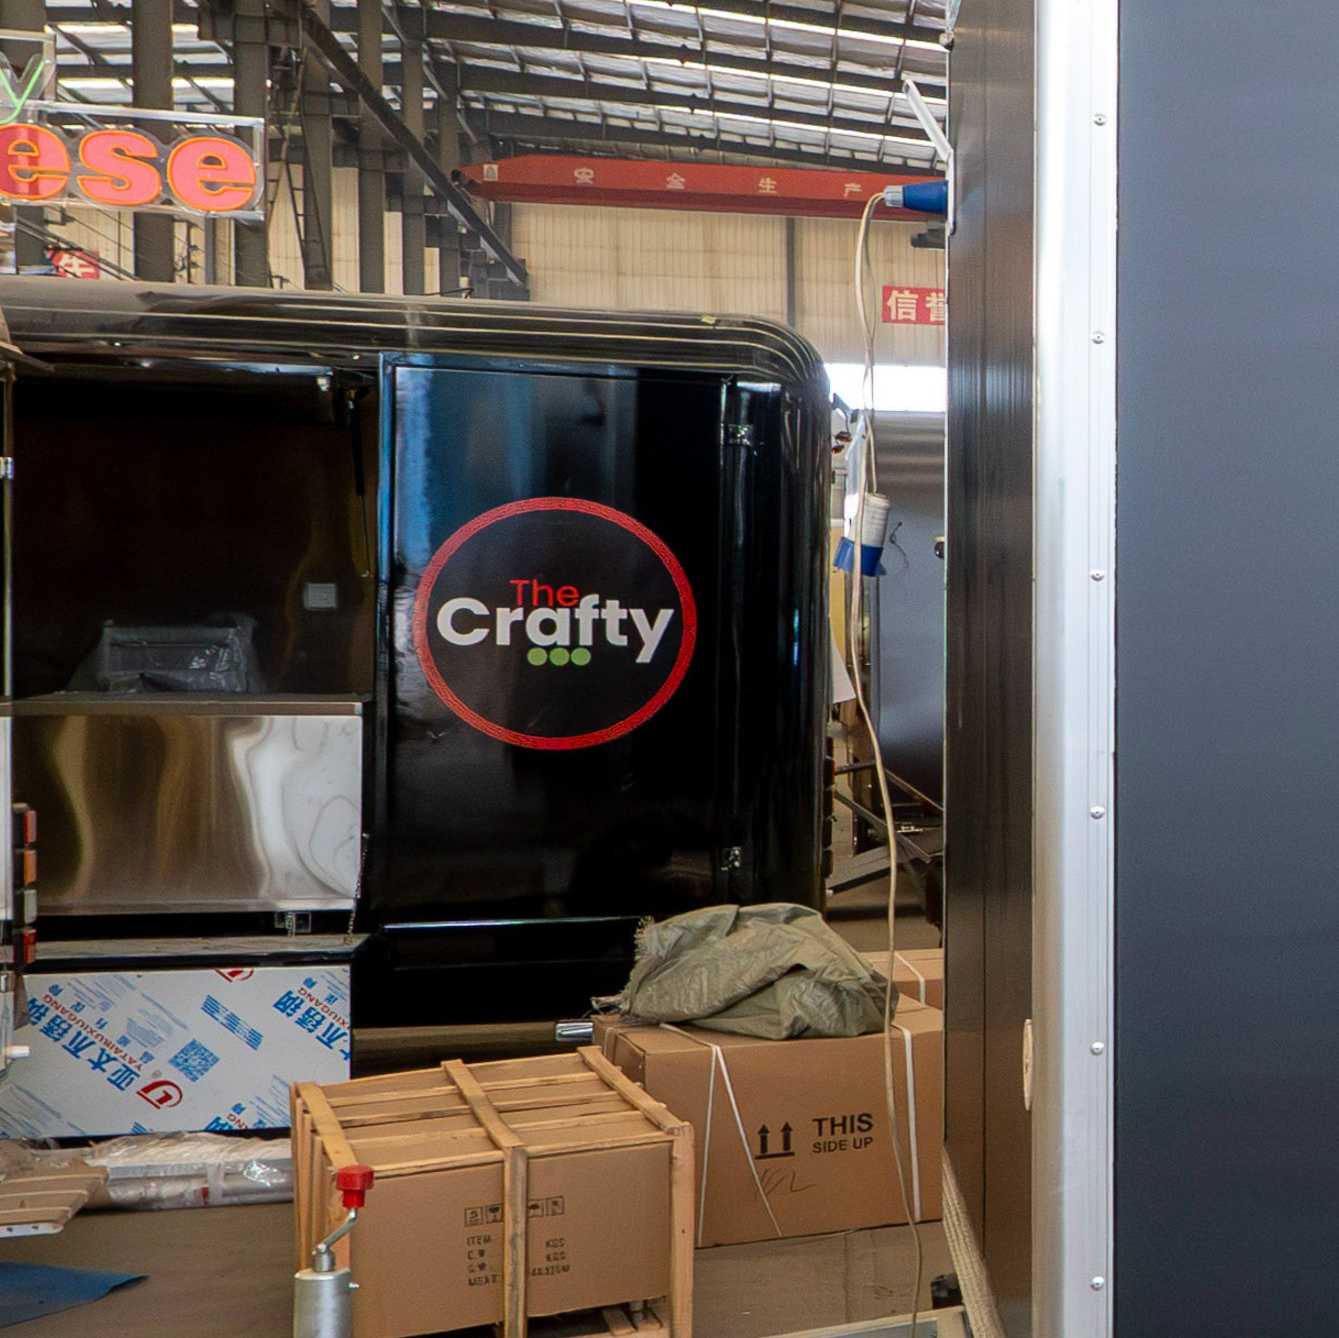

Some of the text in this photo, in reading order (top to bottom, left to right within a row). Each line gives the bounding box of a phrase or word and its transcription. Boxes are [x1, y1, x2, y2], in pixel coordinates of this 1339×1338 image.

[510, 578, 580, 607] The
[436, 594, 675, 663] Crafty
[298, 986, 350, 1032] XIUGANG
[812, 1113, 874, 1137] THIS
[812, 1136, 874, 1154] SIDE UP
